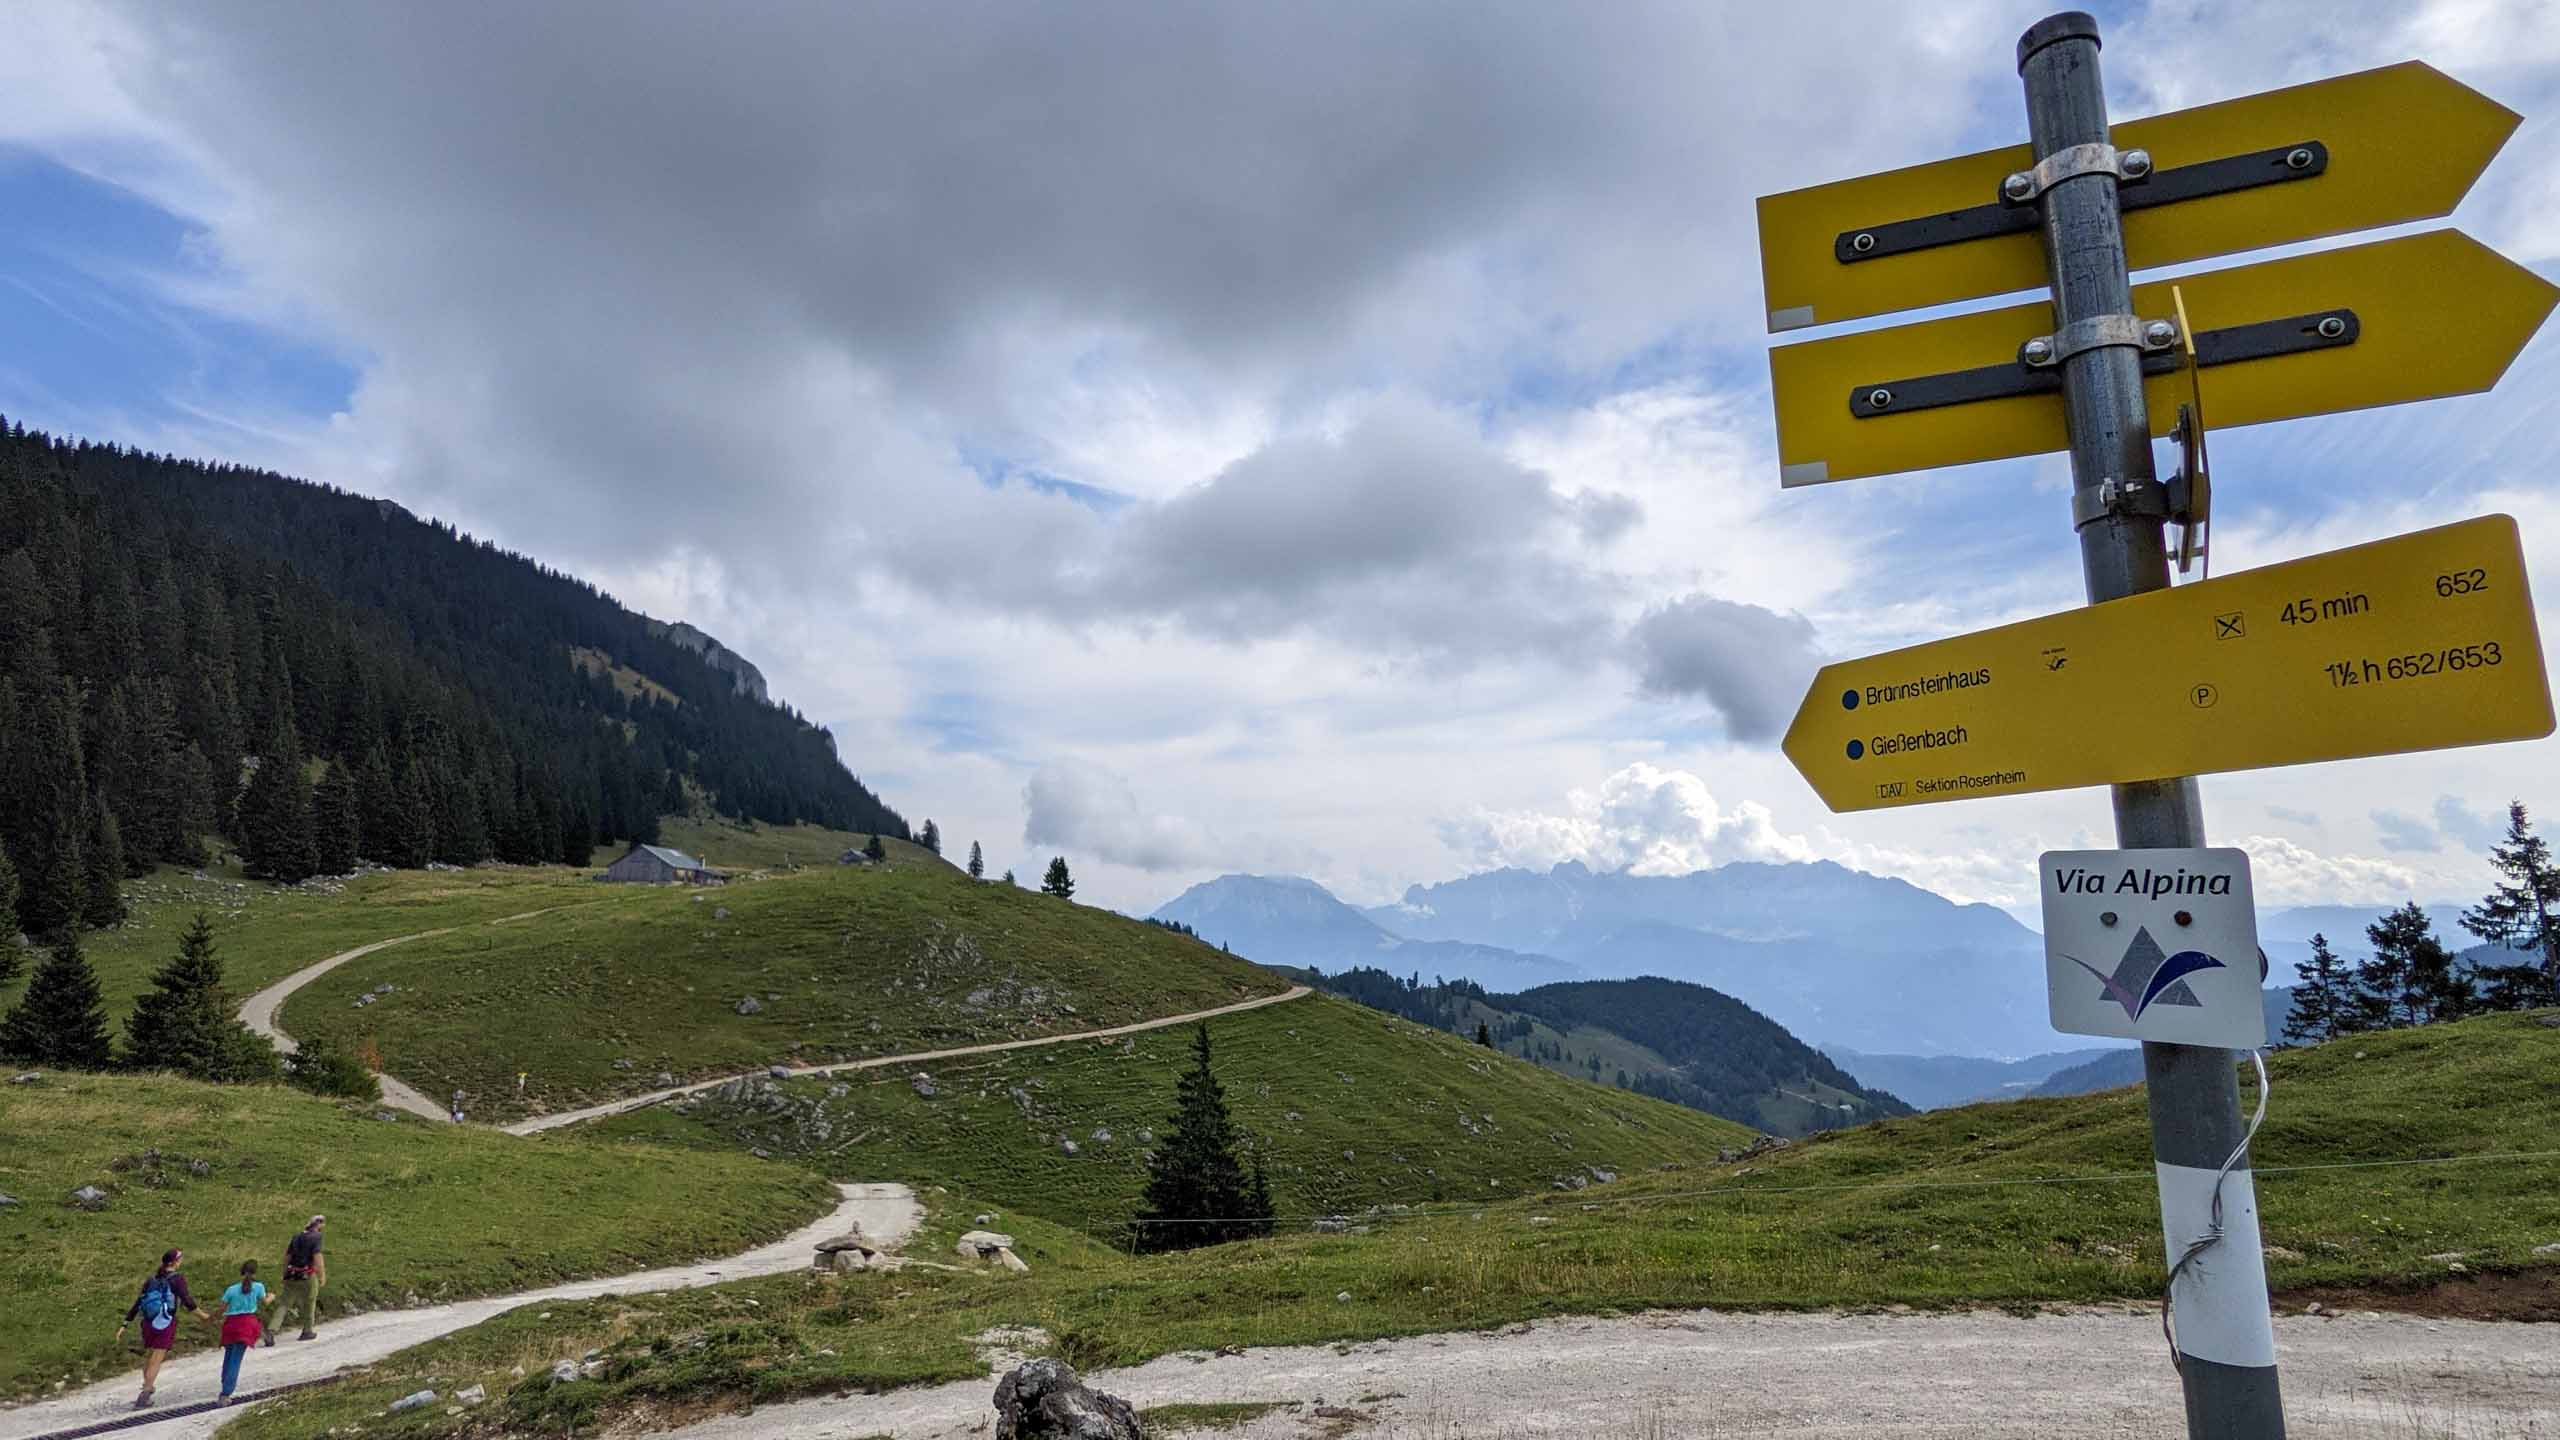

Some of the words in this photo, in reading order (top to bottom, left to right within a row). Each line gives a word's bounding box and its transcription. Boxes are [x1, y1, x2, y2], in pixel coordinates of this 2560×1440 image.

[2435, 568, 2488, 597] 652
[2280, 598, 2317, 625] 45
[2322, 591, 2369, 618] min
[2362, 659, 2381, 683] h
[2387, 642, 2502, 680] 652/653
[1871, 725, 1968, 756] Gießenbach
[1880, 783, 1903, 799] DAV
[1915, 779, 1958, 794] Sektion
[1959, 770, 2026, 789] Rosenheim
[2055, 869, 2105, 894] Via
[2114, 868, 2231, 901] Alpina
